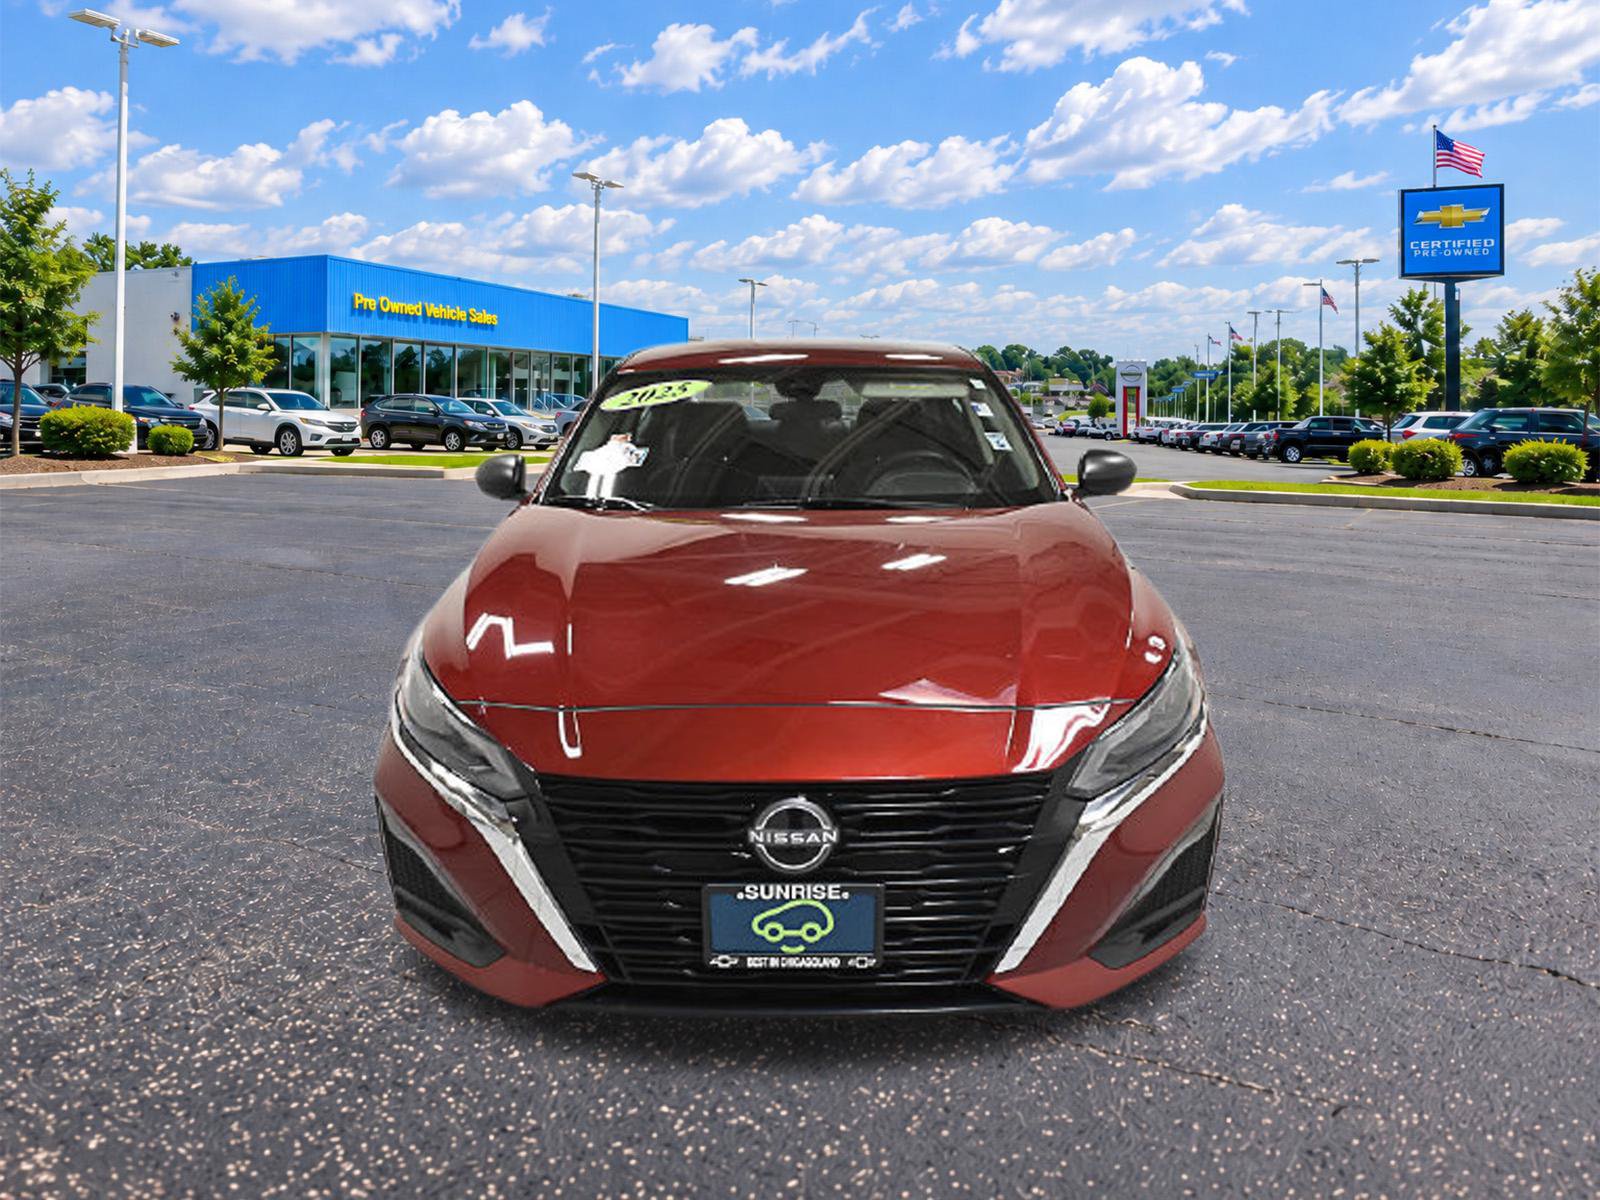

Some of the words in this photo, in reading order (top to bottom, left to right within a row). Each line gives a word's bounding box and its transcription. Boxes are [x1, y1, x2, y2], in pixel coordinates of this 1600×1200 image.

[1410, 239, 1495, 250] CERTIFIED
[1414, 248, 1490, 257] PRE-OWNED
[354, 293, 376, 310] Pre
[379, 296, 422, 316] Owned
[424, 302, 467, 321] Vehicle
[469, 308, 498, 325] Sales
[620, 382, 692, 406] 2025
[749, 830, 838, 845] NISSAN
[744, 884, 841, 900] SUNRISE
[747, 957, 767, 967] BEST
[769, 957, 779, 967] IN
